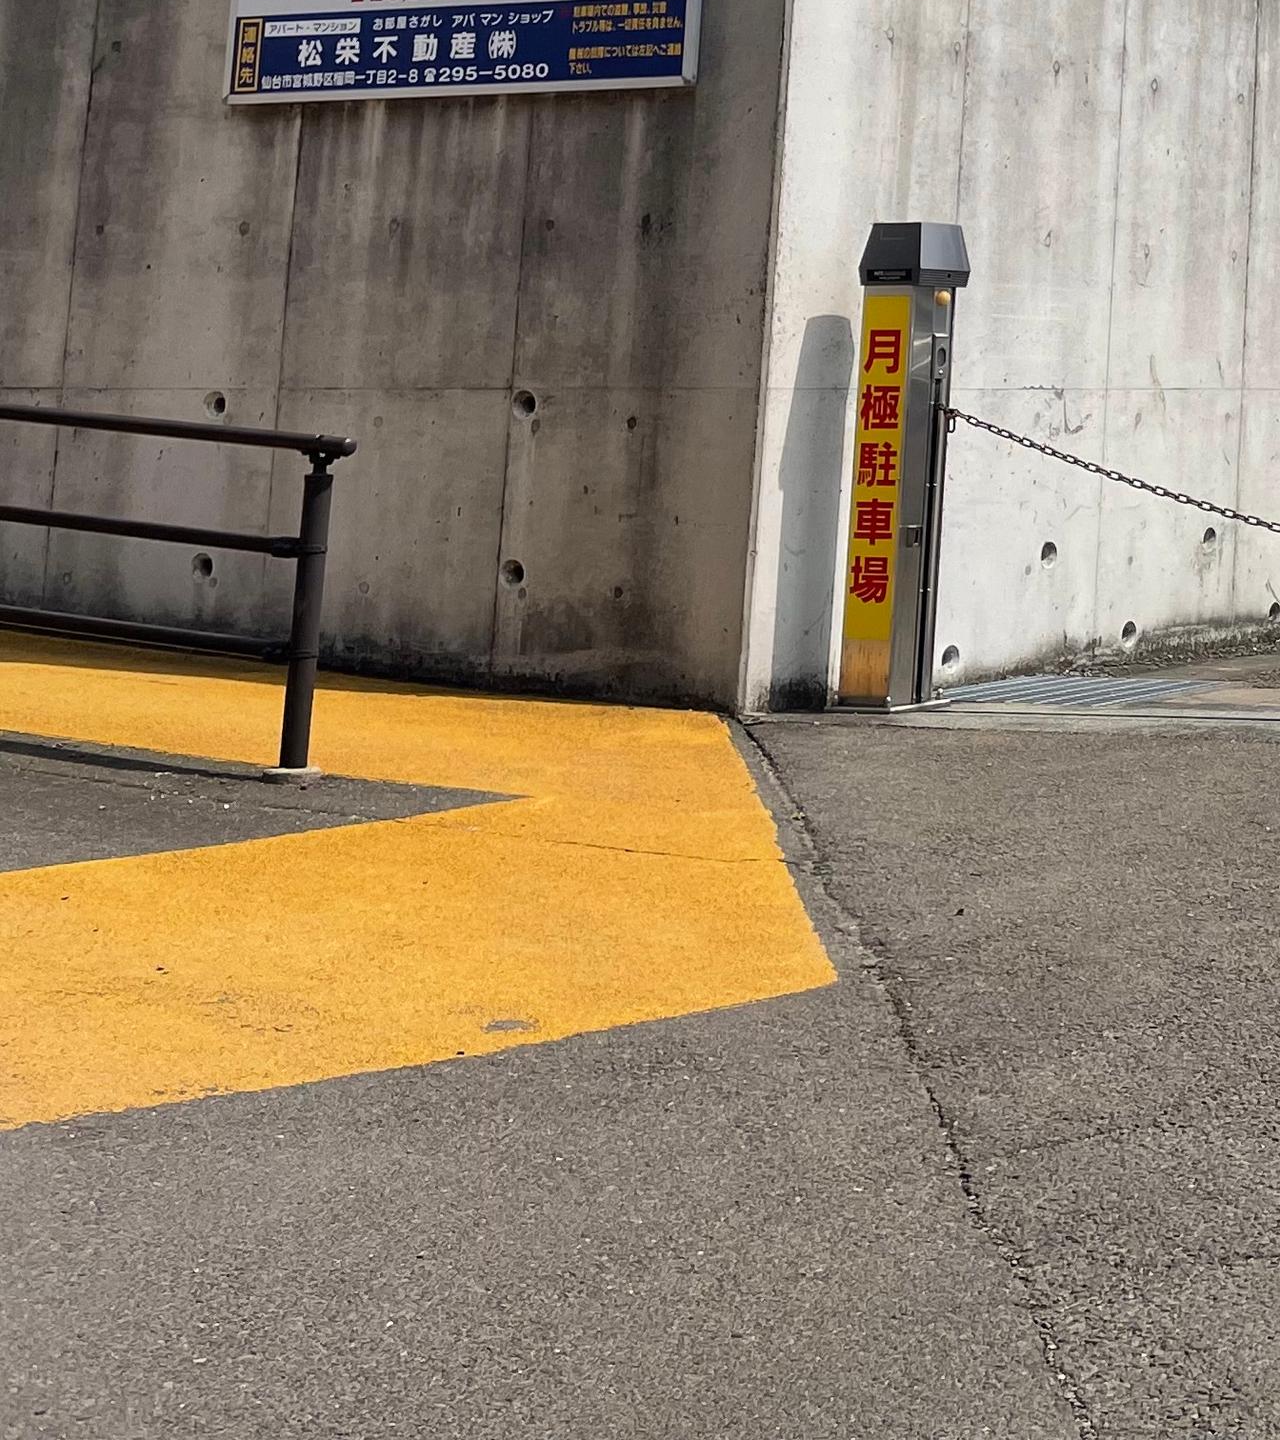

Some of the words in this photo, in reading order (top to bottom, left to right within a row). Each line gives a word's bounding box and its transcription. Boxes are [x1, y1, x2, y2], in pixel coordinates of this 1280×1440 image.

[850, 329, 902, 604] 月極駐車場
